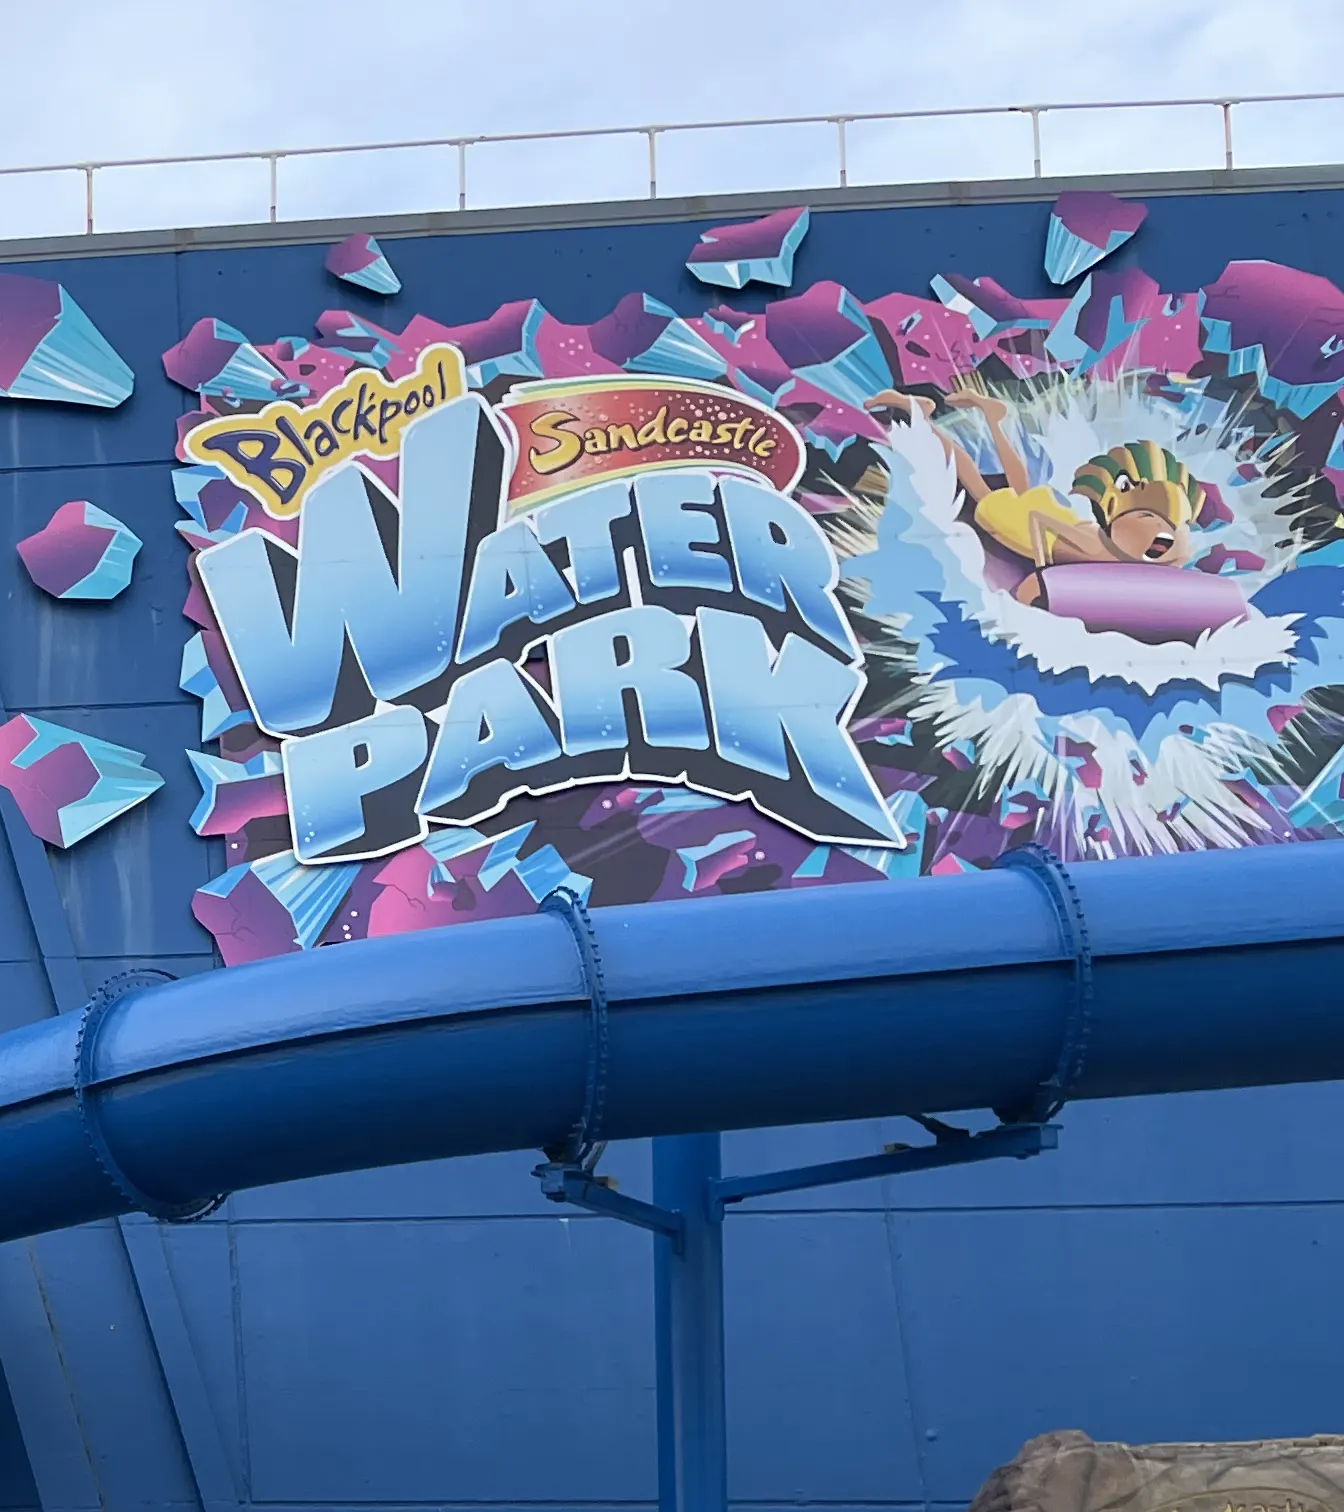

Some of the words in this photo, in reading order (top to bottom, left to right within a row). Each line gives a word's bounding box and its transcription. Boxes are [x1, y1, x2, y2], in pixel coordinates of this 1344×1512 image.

[207, 361, 449, 503] Blackpool
[529, 404, 779, 476] Sandcastle
[198, 393, 862, 731] WATER
[284, 607, 905, 860] PARK
